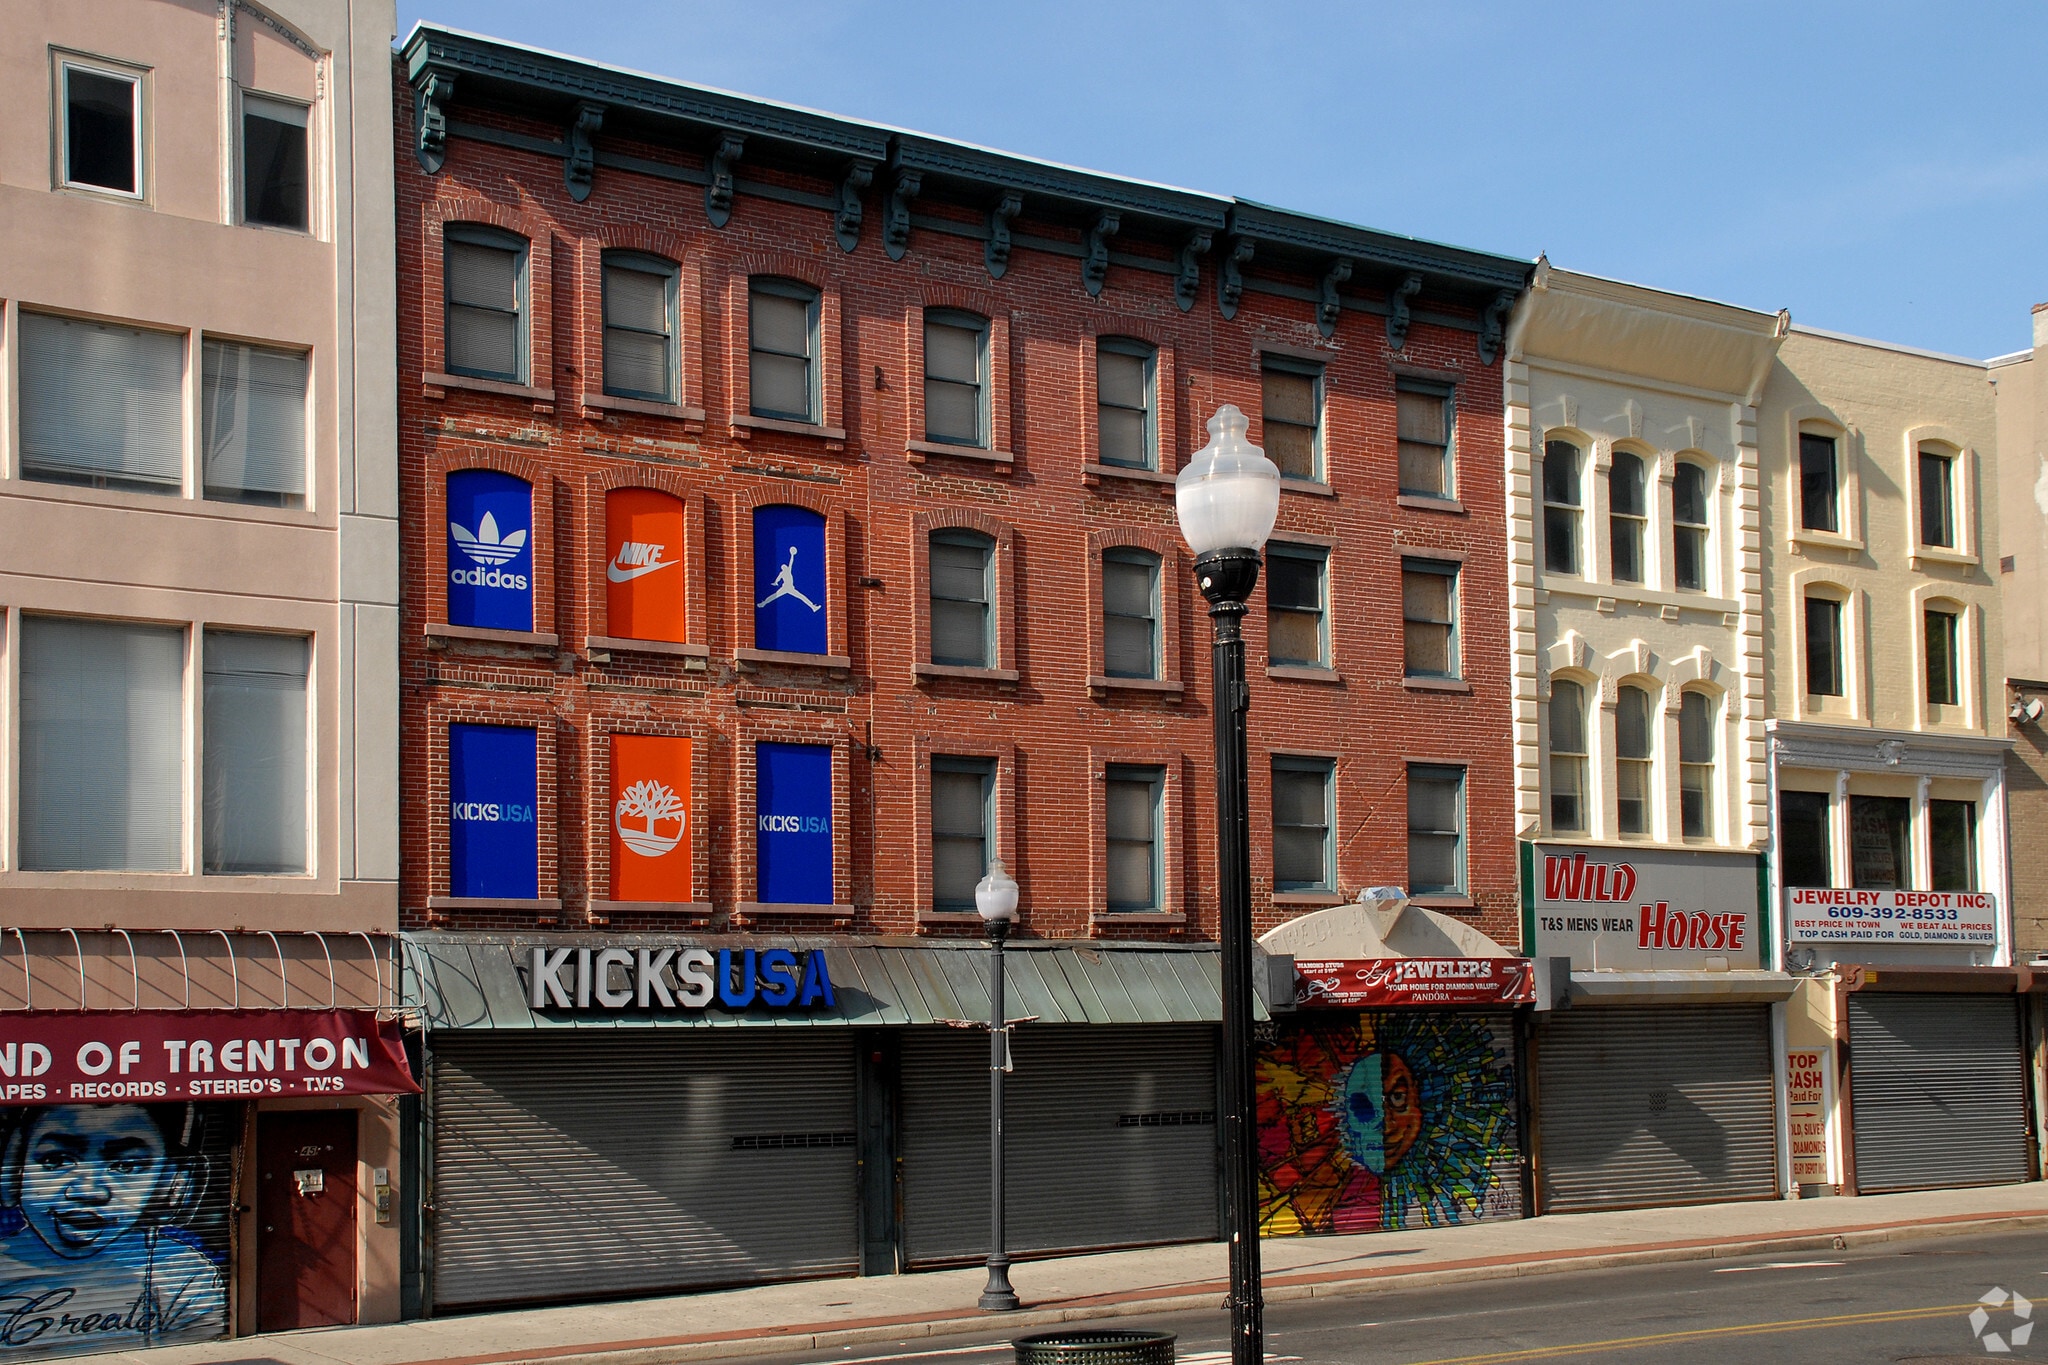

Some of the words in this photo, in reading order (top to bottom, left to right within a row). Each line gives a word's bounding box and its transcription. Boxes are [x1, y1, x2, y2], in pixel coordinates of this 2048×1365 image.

[618, 541, 665, 564] NIKE
[451, 566, 528, 590] adidas
[452, 802, 533, 823] KICKSUSA
[759, 814, 829, 834] KICKSUSA
[1793, 890, 1880, 905] JEWELRY
[1894, 893, 1951, 907] DEPOT
[1957, 895, 1991, 908] INC.
[1828, 907, 1958, 920] 609-392-8533
[1541, 917, 1563, 931] T&S
[1567, 918, 1598, 932] MENS
[1602, 918, 1634, 932] WEAR
[1818, 920, 1842, 928] PRICE
[1917, 922, 1940, 930] BEAT
[1798, 930, 1818, 938] TOP
[1821, 930, 1848, 938] CASH
[1899, 931, 1922, 940] GOLD,
[1924, 932, 1958, 940] DIAMOND
[1960, 932, 1965, 940] &
[528, 947, 836, 1008] KICKSUSA
[1395, 961, 1492, 983] JEWELERS
[0, 1043, 52, 1077] ND
[76, 1041, 140, 1076] OF
[164, 1037, 369, 1074] TRENTON
[1788, 1055, 1817, 1068] TOP
[70, 1081, 166, 1098] RECORDS
[189, 1078, 281, 1095] STEREO'S
[1808, 1091, 1821, 1101] For
[1793, 1140, 1826, 1153] DIAMONDS
